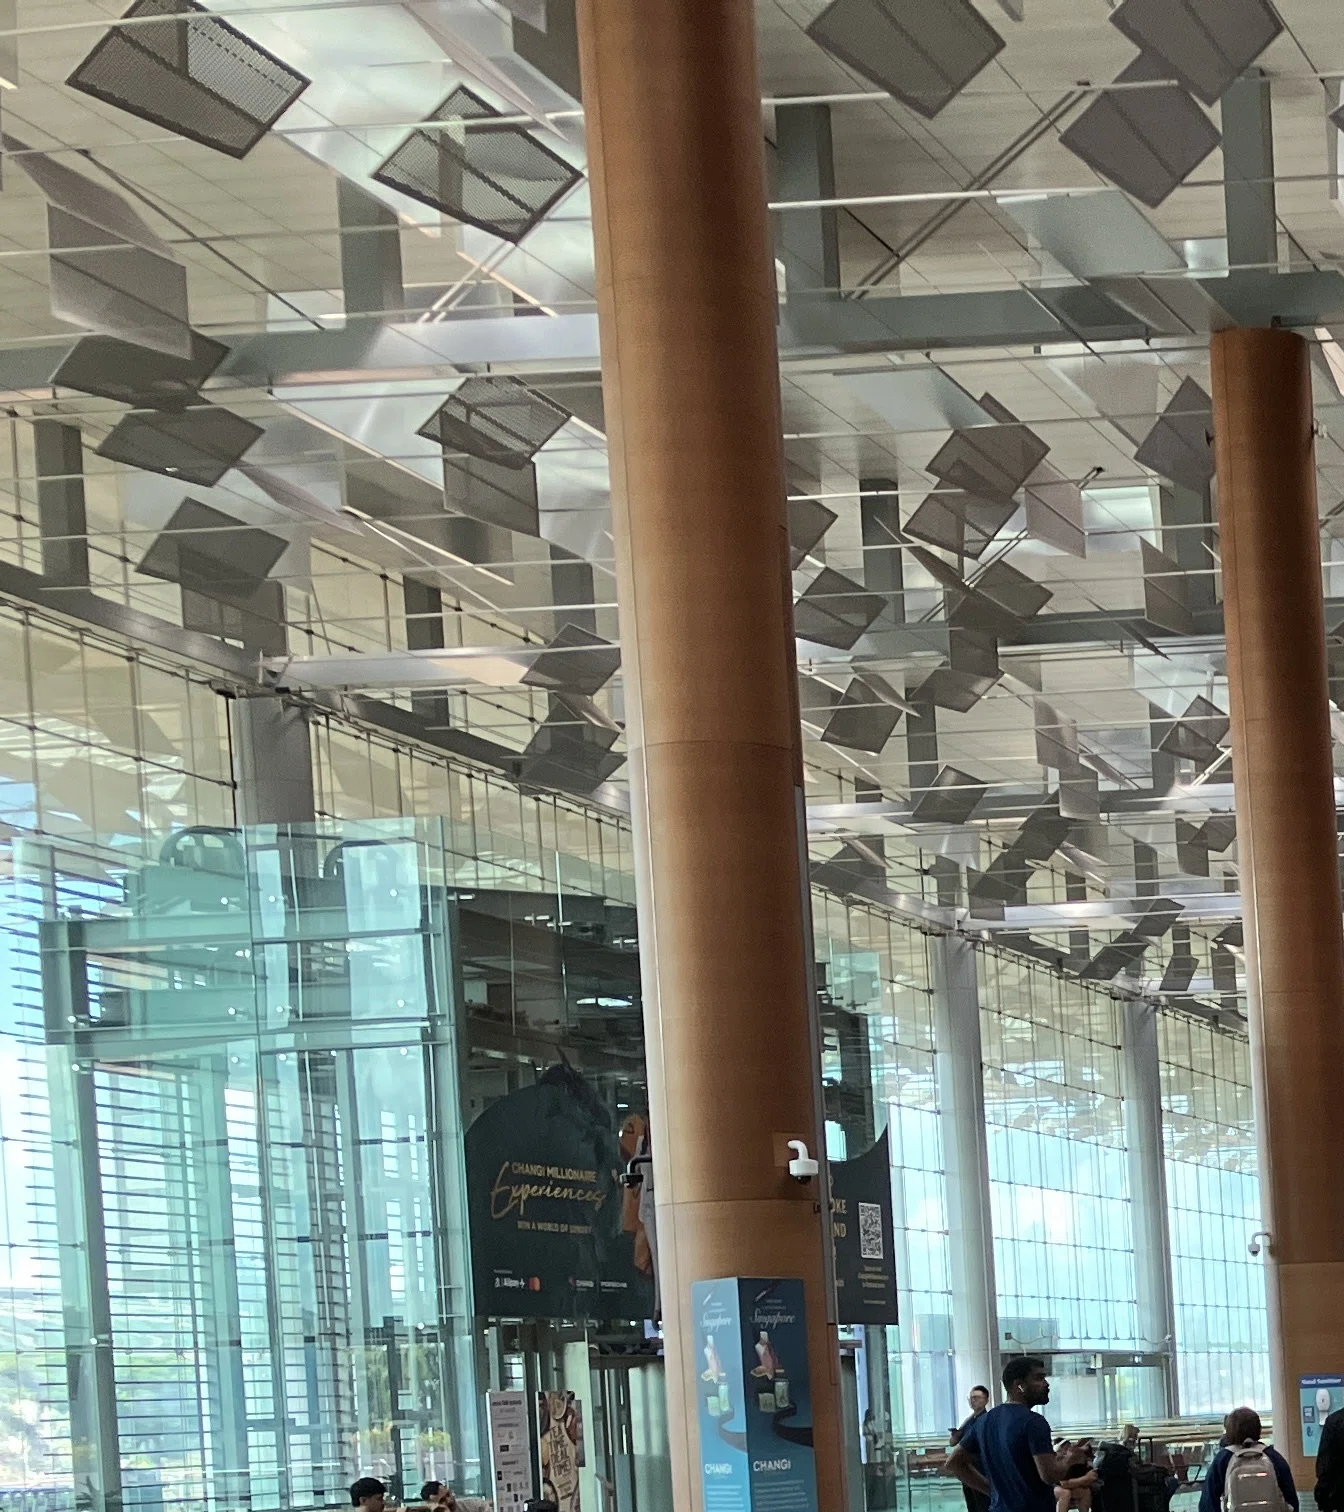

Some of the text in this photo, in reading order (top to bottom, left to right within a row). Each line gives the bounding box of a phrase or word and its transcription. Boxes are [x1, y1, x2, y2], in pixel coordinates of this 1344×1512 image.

[511, 1162, 597, 1182] CHANGI MILLIONAIRE
[490, 1161, 607, 1220] Experiences
[704, 1463, 732, 1475] CHANGI
[753, 1458, 791, 1473] CHANGI
